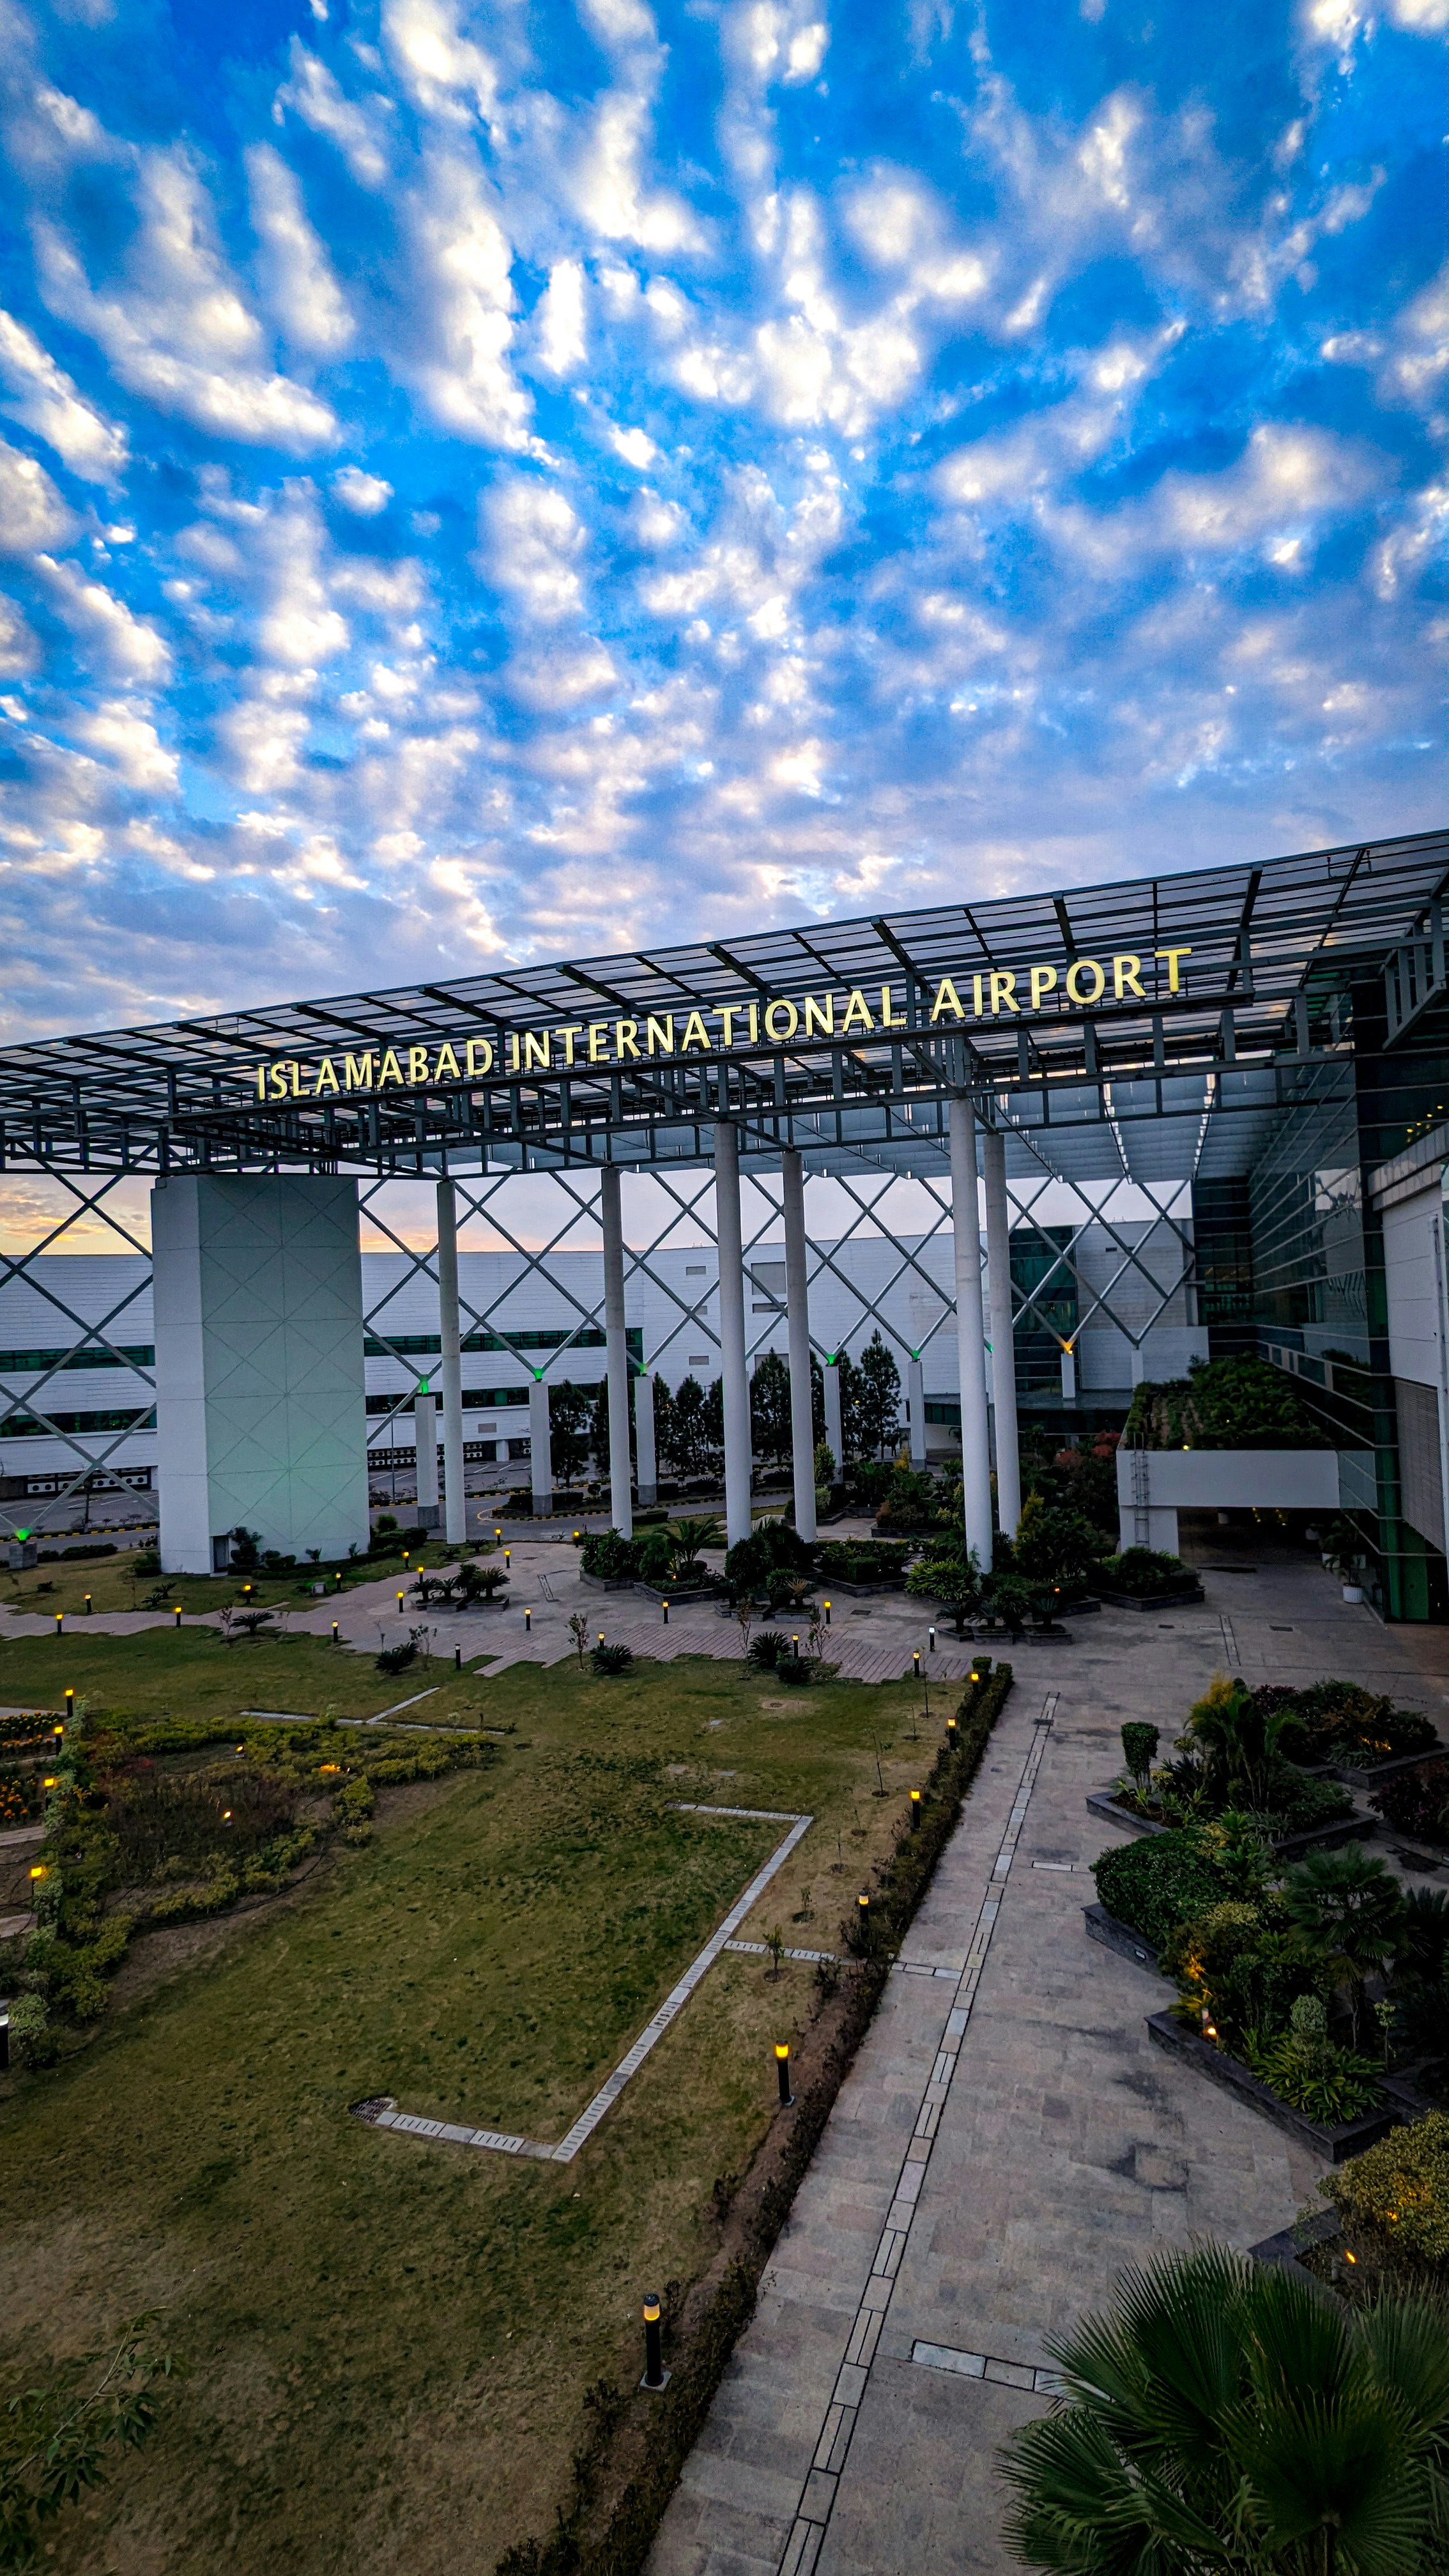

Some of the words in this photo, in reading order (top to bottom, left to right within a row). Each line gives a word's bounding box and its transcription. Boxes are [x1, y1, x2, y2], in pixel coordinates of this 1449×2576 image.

[258, 1039, 493, 1100] ISLAMABAD
[512, 986, 906, 1071] INTERNATIONAL
[931, 948, 1192, 1023] AIRPORT
